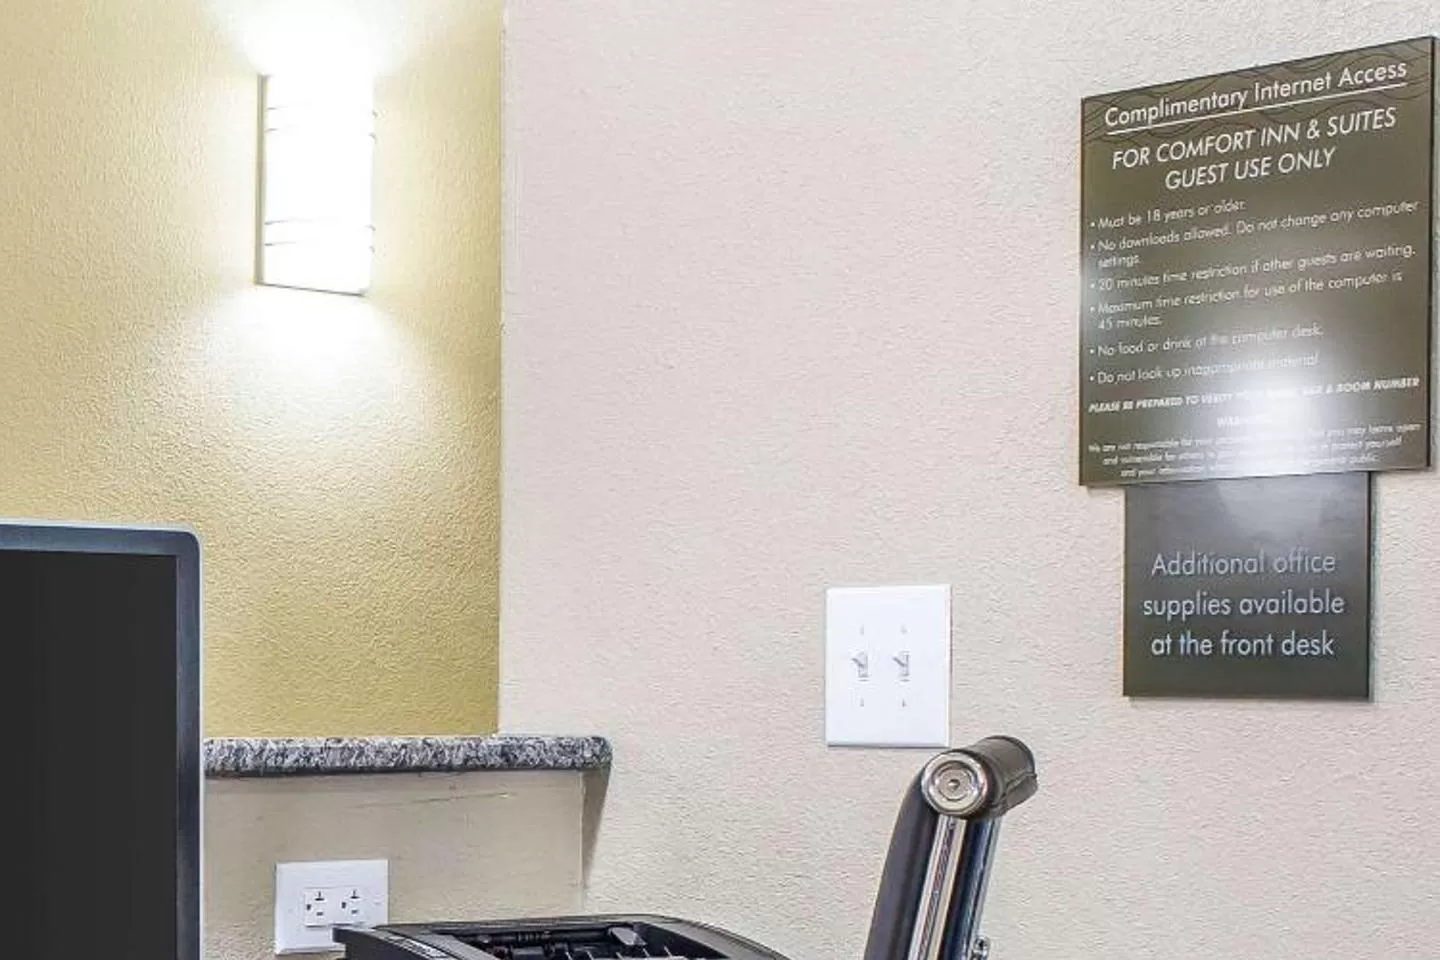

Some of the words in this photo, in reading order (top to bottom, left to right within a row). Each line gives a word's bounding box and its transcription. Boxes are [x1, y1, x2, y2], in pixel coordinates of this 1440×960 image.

[1105, 90, 1248, 127] Complimentary
[1254, 71, 1332, 102] Internet
[1337, 62, 1408, 88] Access
[1112, 147, 1150, 170] FOR
[1156, 128, 1257, 163] COMFORT
[1260, 122, 1301, 147] INN
[1306, 119, 1321, 140] &
[1326, 106, 1397, 138] SUITES
[1165, 162, 1229, 190] GUEST
[1234, 156, 1272, 180] USE
[1278, 147, 1336, 174] ONLY
[1098, 240, 1117, 252] No
[1119, 229, 1181, 250] downloads
[1236, 220, 1256, 236] Do
[1258, 217, 1278, 232] not
[1280, 213, 1328, 229] change
[1330, 209, 1355, 223] any
[1357, 200, 1418, 219] computer
[1128, 213, 1142, 225] be
[1147, 208, 1161, 223] 18
[1164, 207, 1195, 224] years
[1098, 278, 1114, 291] 20
[1263, 257, 1292, 274] other
[1297, 253, 1338, 272] guests
[1340, 249, 1362, 264] are
[1364, 243, 1417, 259] waiting.
[1098, 300, 1153, 315] Maximum
[1264, 284, 1286, 298] use
[1304, 276, 1325, 292] the
[1328, 272, 1388, 289] computer
[1098, 344, 1115, 357] No
[1118, 339, 1143, 355] food
[1162, 335, 1193, 352] drink
[1098, 370, 1115, 384] Do
[1117, 367, 1136, 385] not
[1138, 365, 1161, 380] look
[1151, 547, 1265, 576] Additional
[1272, 547, 1336, 574] office
[1143, 590, 1231, 621] supplies
[1239, 588, 1345, 616] available
[1151, 633, 1171, 655] at
[1179, 630, 1213, 655] the
[1220, 629, 1273, 656] front
[1281, 629, 1335, 655] desk
